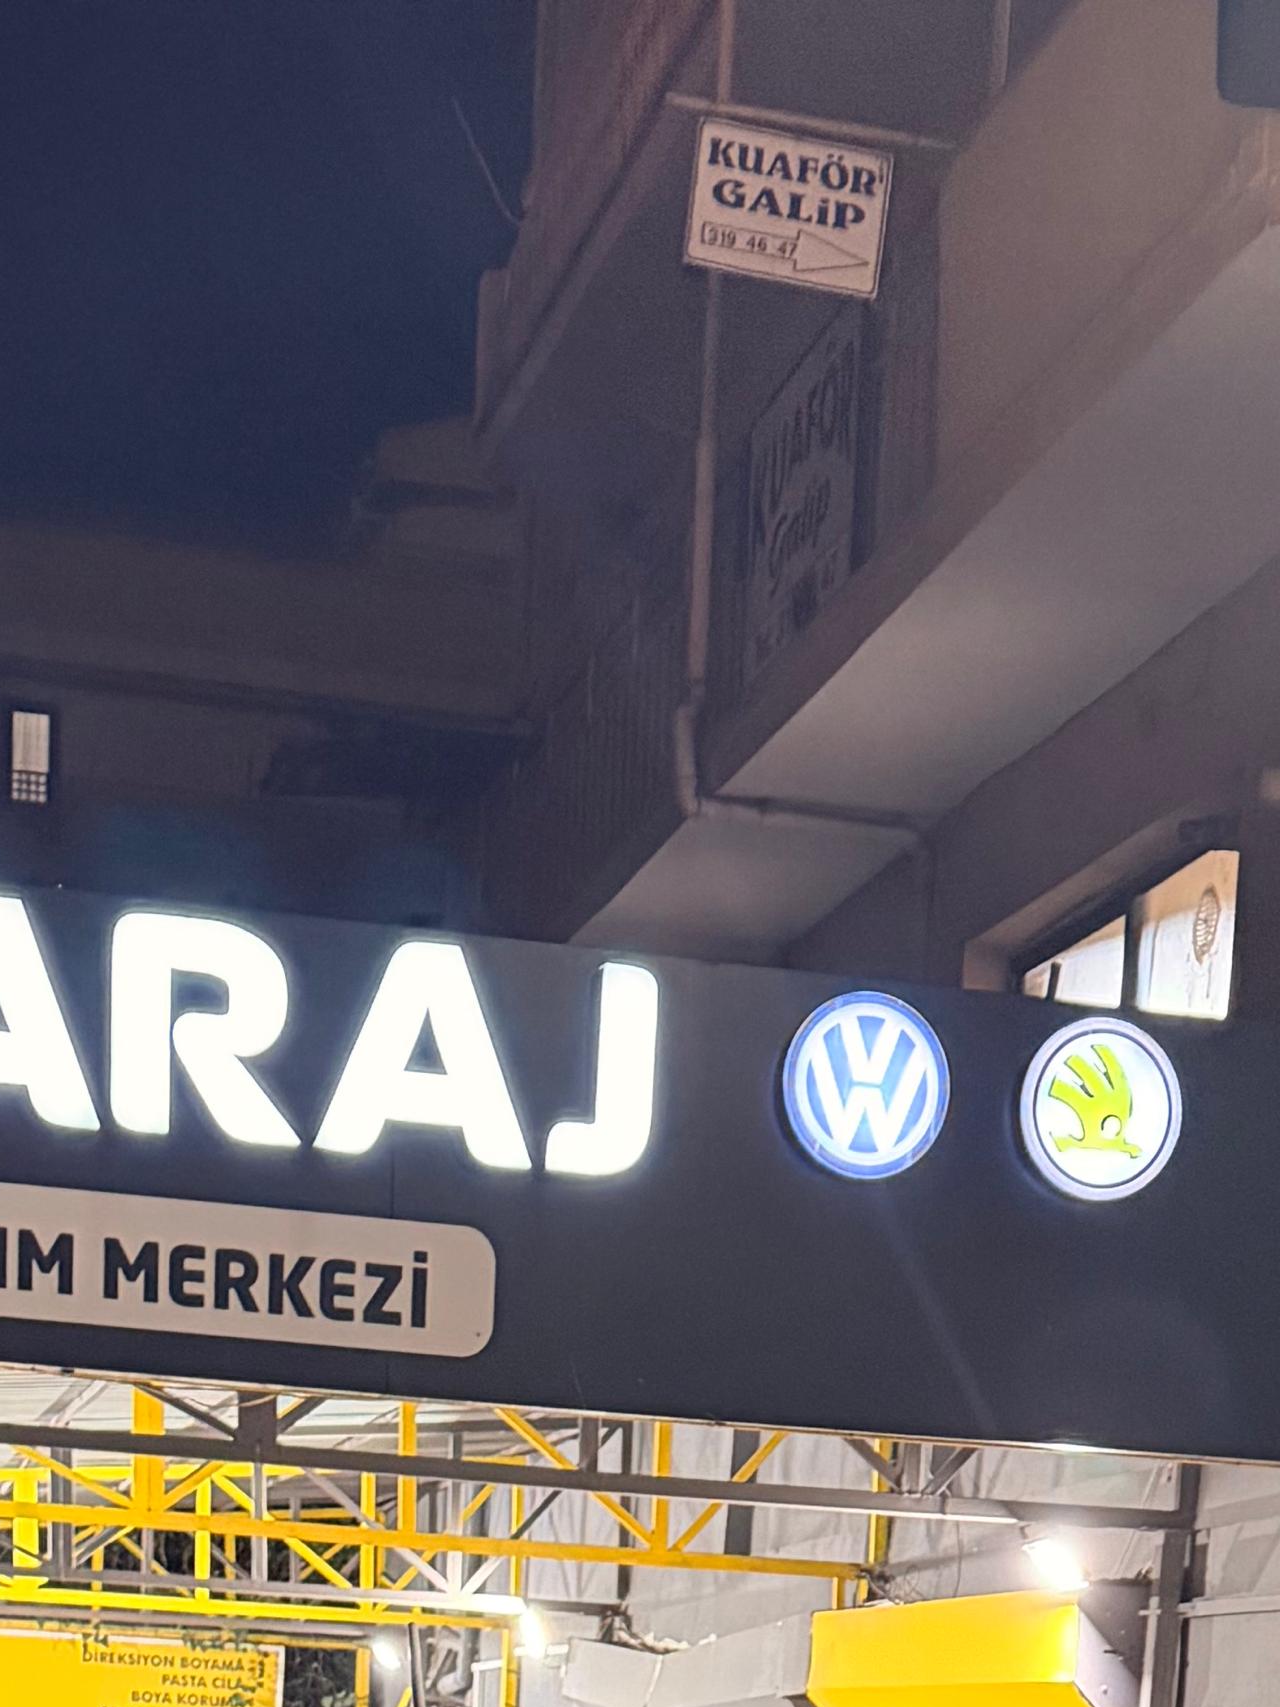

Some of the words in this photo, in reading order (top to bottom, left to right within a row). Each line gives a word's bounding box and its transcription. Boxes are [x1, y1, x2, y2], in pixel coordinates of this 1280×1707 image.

[708, 137, 876, 196] KUAFÖR
[104, 1240, 428, 1328] MERKEZİ
[180, 1656, 244, 1672] BOYAMA
[162, 1673, 207, 1688] PASTA
[131, 1690, 172, 1704] BOYA
